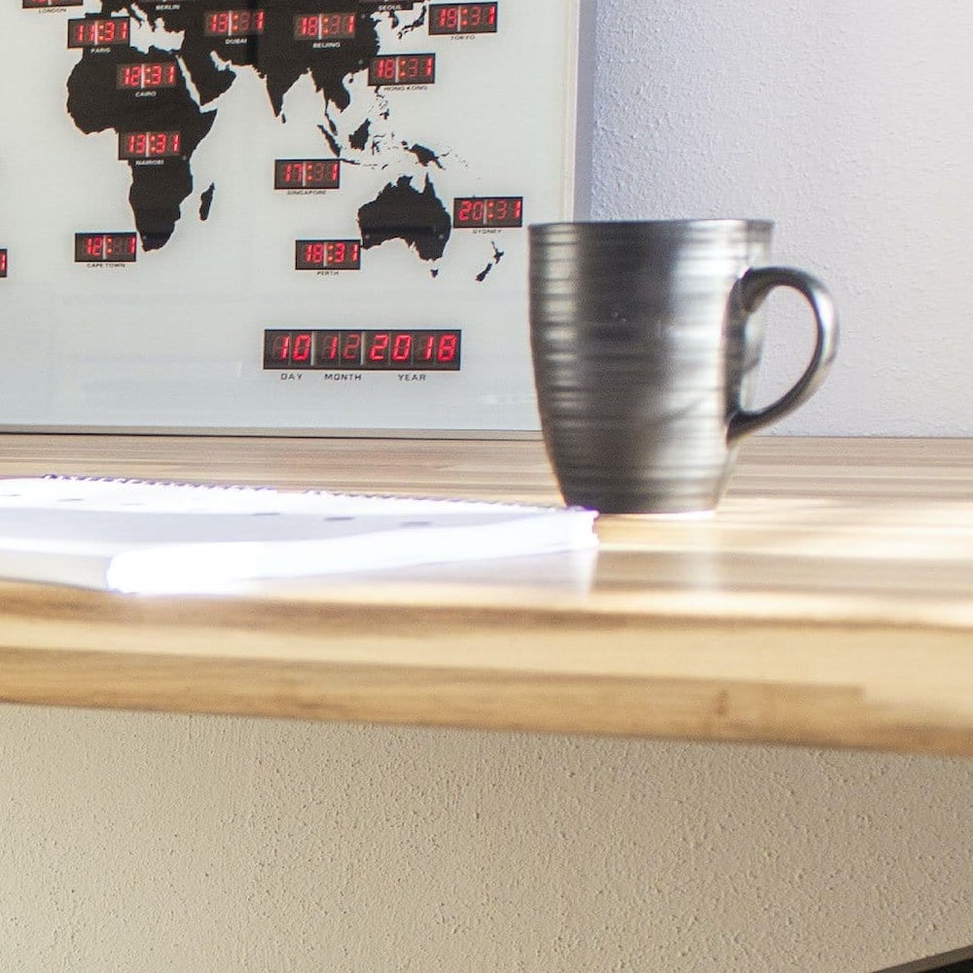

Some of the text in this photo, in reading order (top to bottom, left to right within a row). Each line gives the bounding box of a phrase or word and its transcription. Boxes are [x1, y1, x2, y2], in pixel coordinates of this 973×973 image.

[77, 21, 128, 42] 11:31
[122, 65, 175, 87] 12:31
[128, 133, 180, 154] 13:31
[459, 200, 521, 221] 20:31
[306, 243, 358, 263] 18:31
[280, 333, 313, 361] 10
[329, 333, 361, 360] 12
[280, 373, 303, 381] DAY
[324, 373, 362, 381] MONTH
